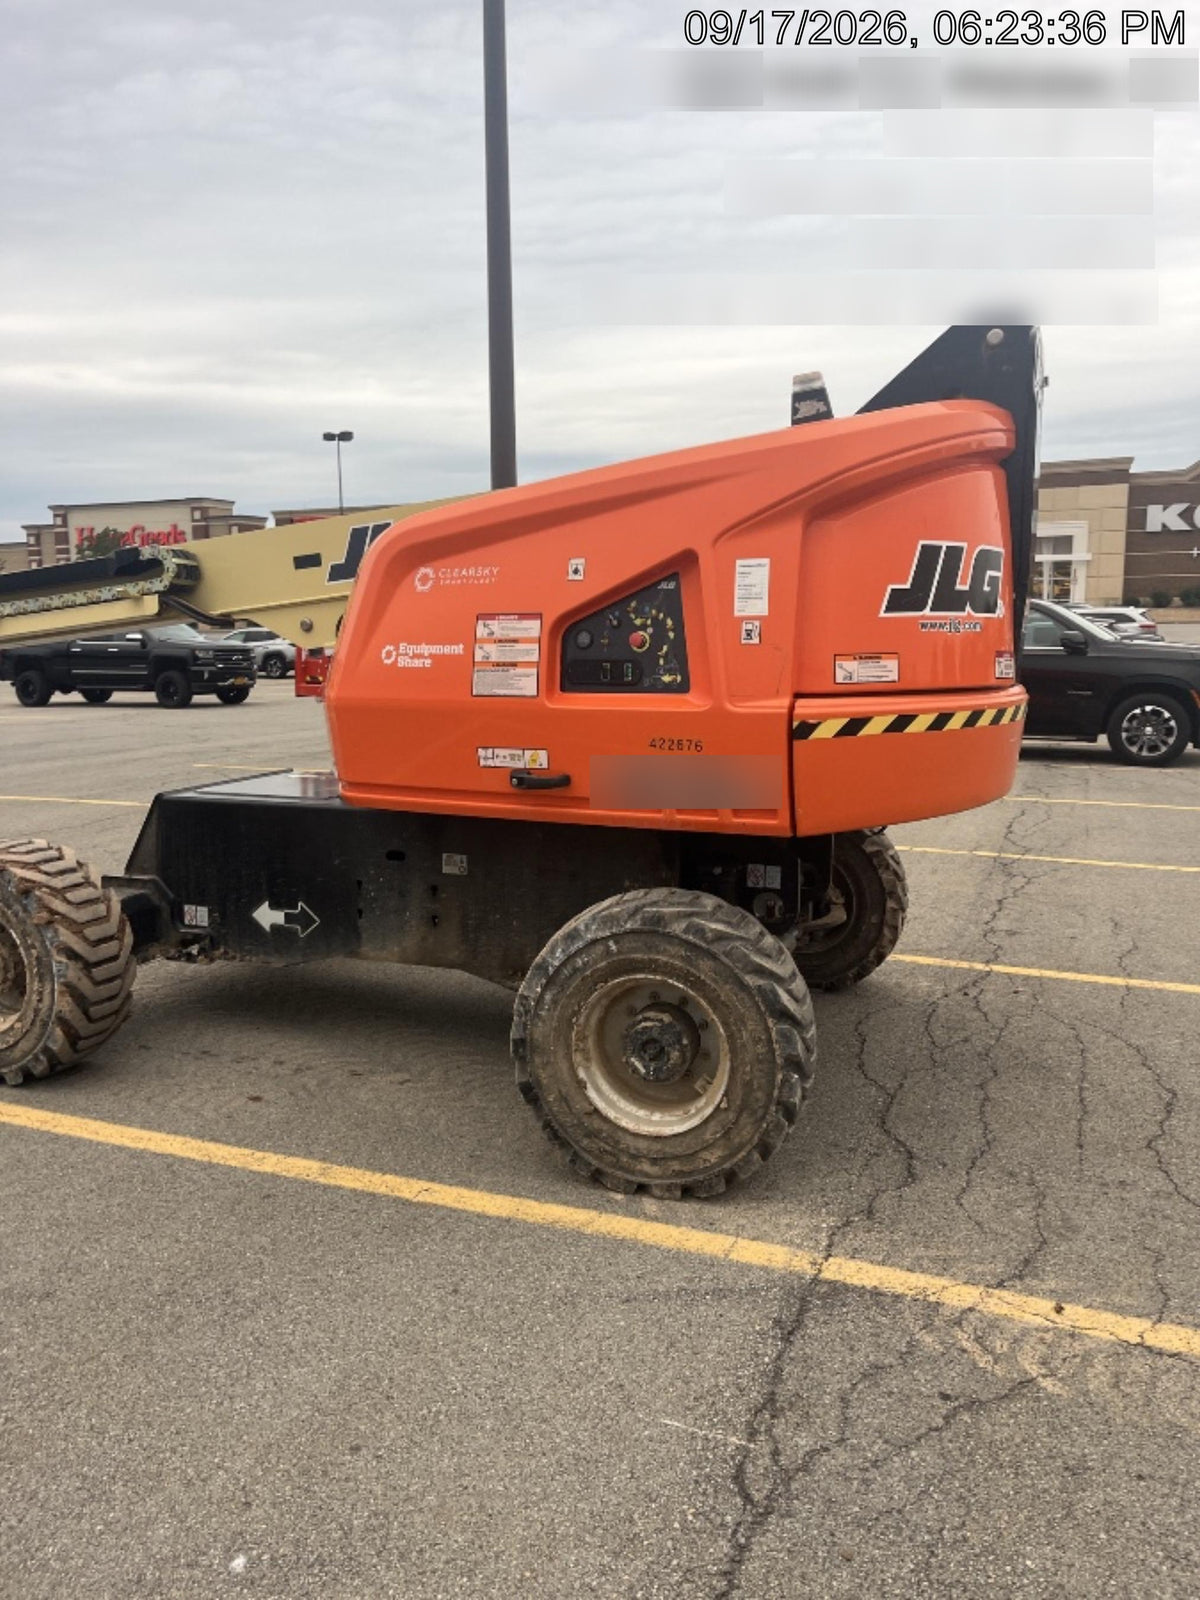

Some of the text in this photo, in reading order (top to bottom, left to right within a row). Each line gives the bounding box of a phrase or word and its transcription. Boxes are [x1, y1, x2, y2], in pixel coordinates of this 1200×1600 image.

[1146, 503, 1200, 532] K
[439, 566, 499, 578] CLEARSKY
[879, 540, 1004, 618] JLG
[918, 619, 982, 634] www.jlg.com
[399, 643, 464, 656] Equipment
[397, 656, 432, 668] Share
